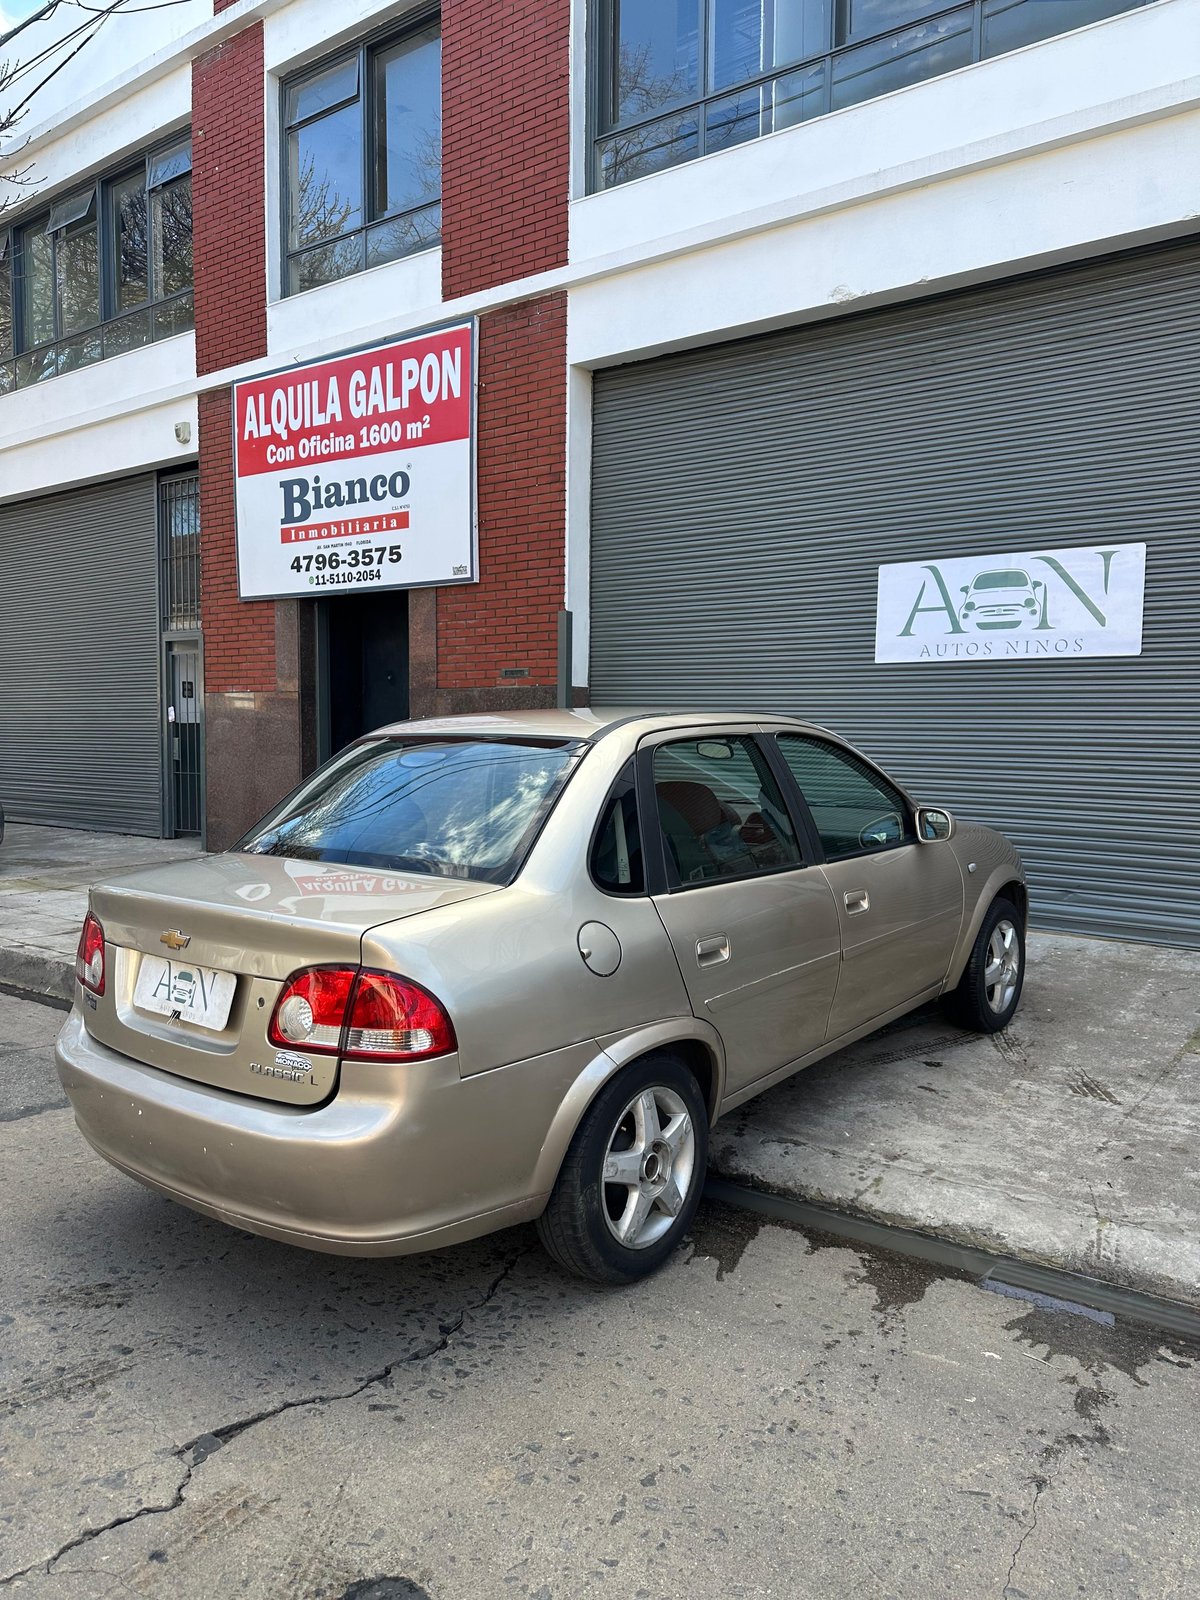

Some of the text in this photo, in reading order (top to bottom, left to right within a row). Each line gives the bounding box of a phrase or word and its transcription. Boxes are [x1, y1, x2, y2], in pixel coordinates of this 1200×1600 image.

[243, 346, 462, 441] ALQUILA GALPON
[266, 444, 295, 464] Con
[298, 433, 355, 458] Oficina
[359, 420, 402, 448] 1600
[279, 470, 410, 525] Bianco
[290, 517, 398, 541] Inmobiliaria
[290, 545, 402, 573] 4796-3575
[315, 568, 382, 586] 11-5110-2054
[919, 638, 1084, 658] AUTOS NINOS
[249, 1062, 305, 1084] CLASSIC
[275, 1057, 312, 1070] MONACO
